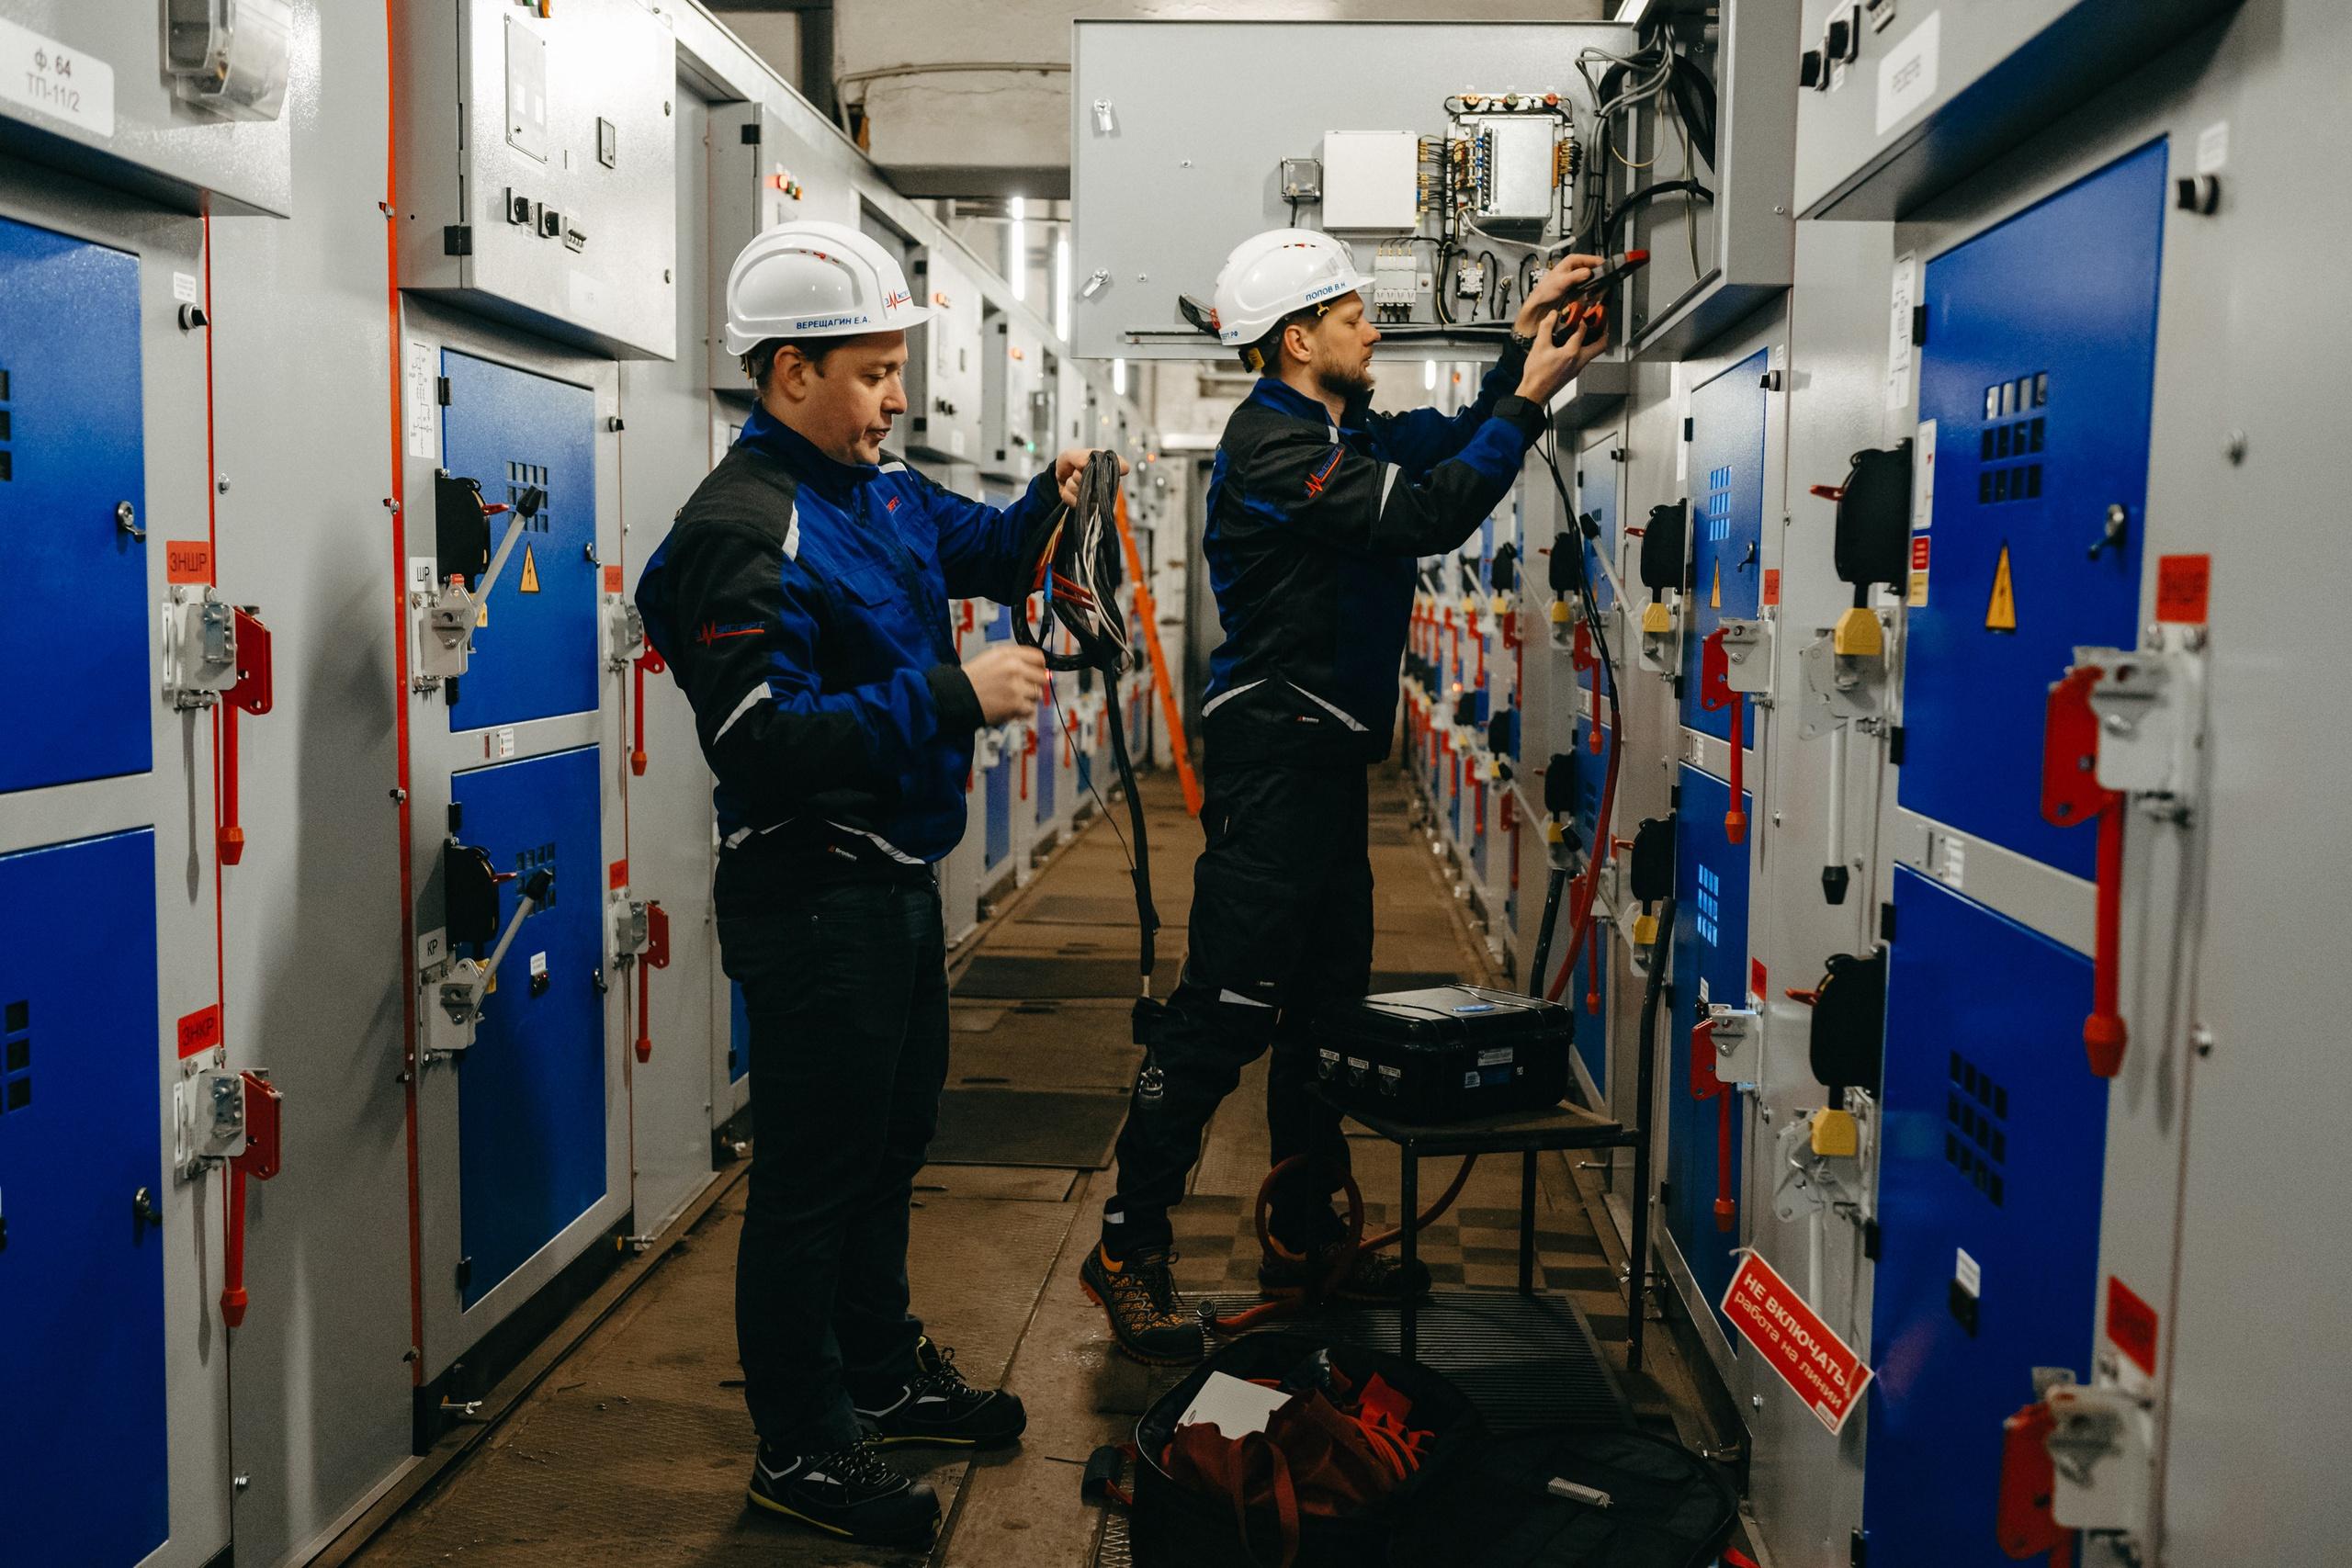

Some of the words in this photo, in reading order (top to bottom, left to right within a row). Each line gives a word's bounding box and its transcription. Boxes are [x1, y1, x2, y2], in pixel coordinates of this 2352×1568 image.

[34, 48, 51, 73] ф.
[55, 55, 72, 79] 64
[1306, 286, 1333, 302] ПОПОВ
[796, 317, 852, 330] ВЕРЕЩАГИН
[169, 552, 208, 572] ЗНШР
[416, 566, 430, 582] ШР
[427, 938, 438, 956] КР
[182, 1016, 214, 1046] ЗНКР
[1743, 1273, 1767, 1302] НЕ
[1734, 1291, 1781, 1343] работа
[1780, 1340, 1799, 1364] на
[1798, 1361, 1843, 1410] линии
